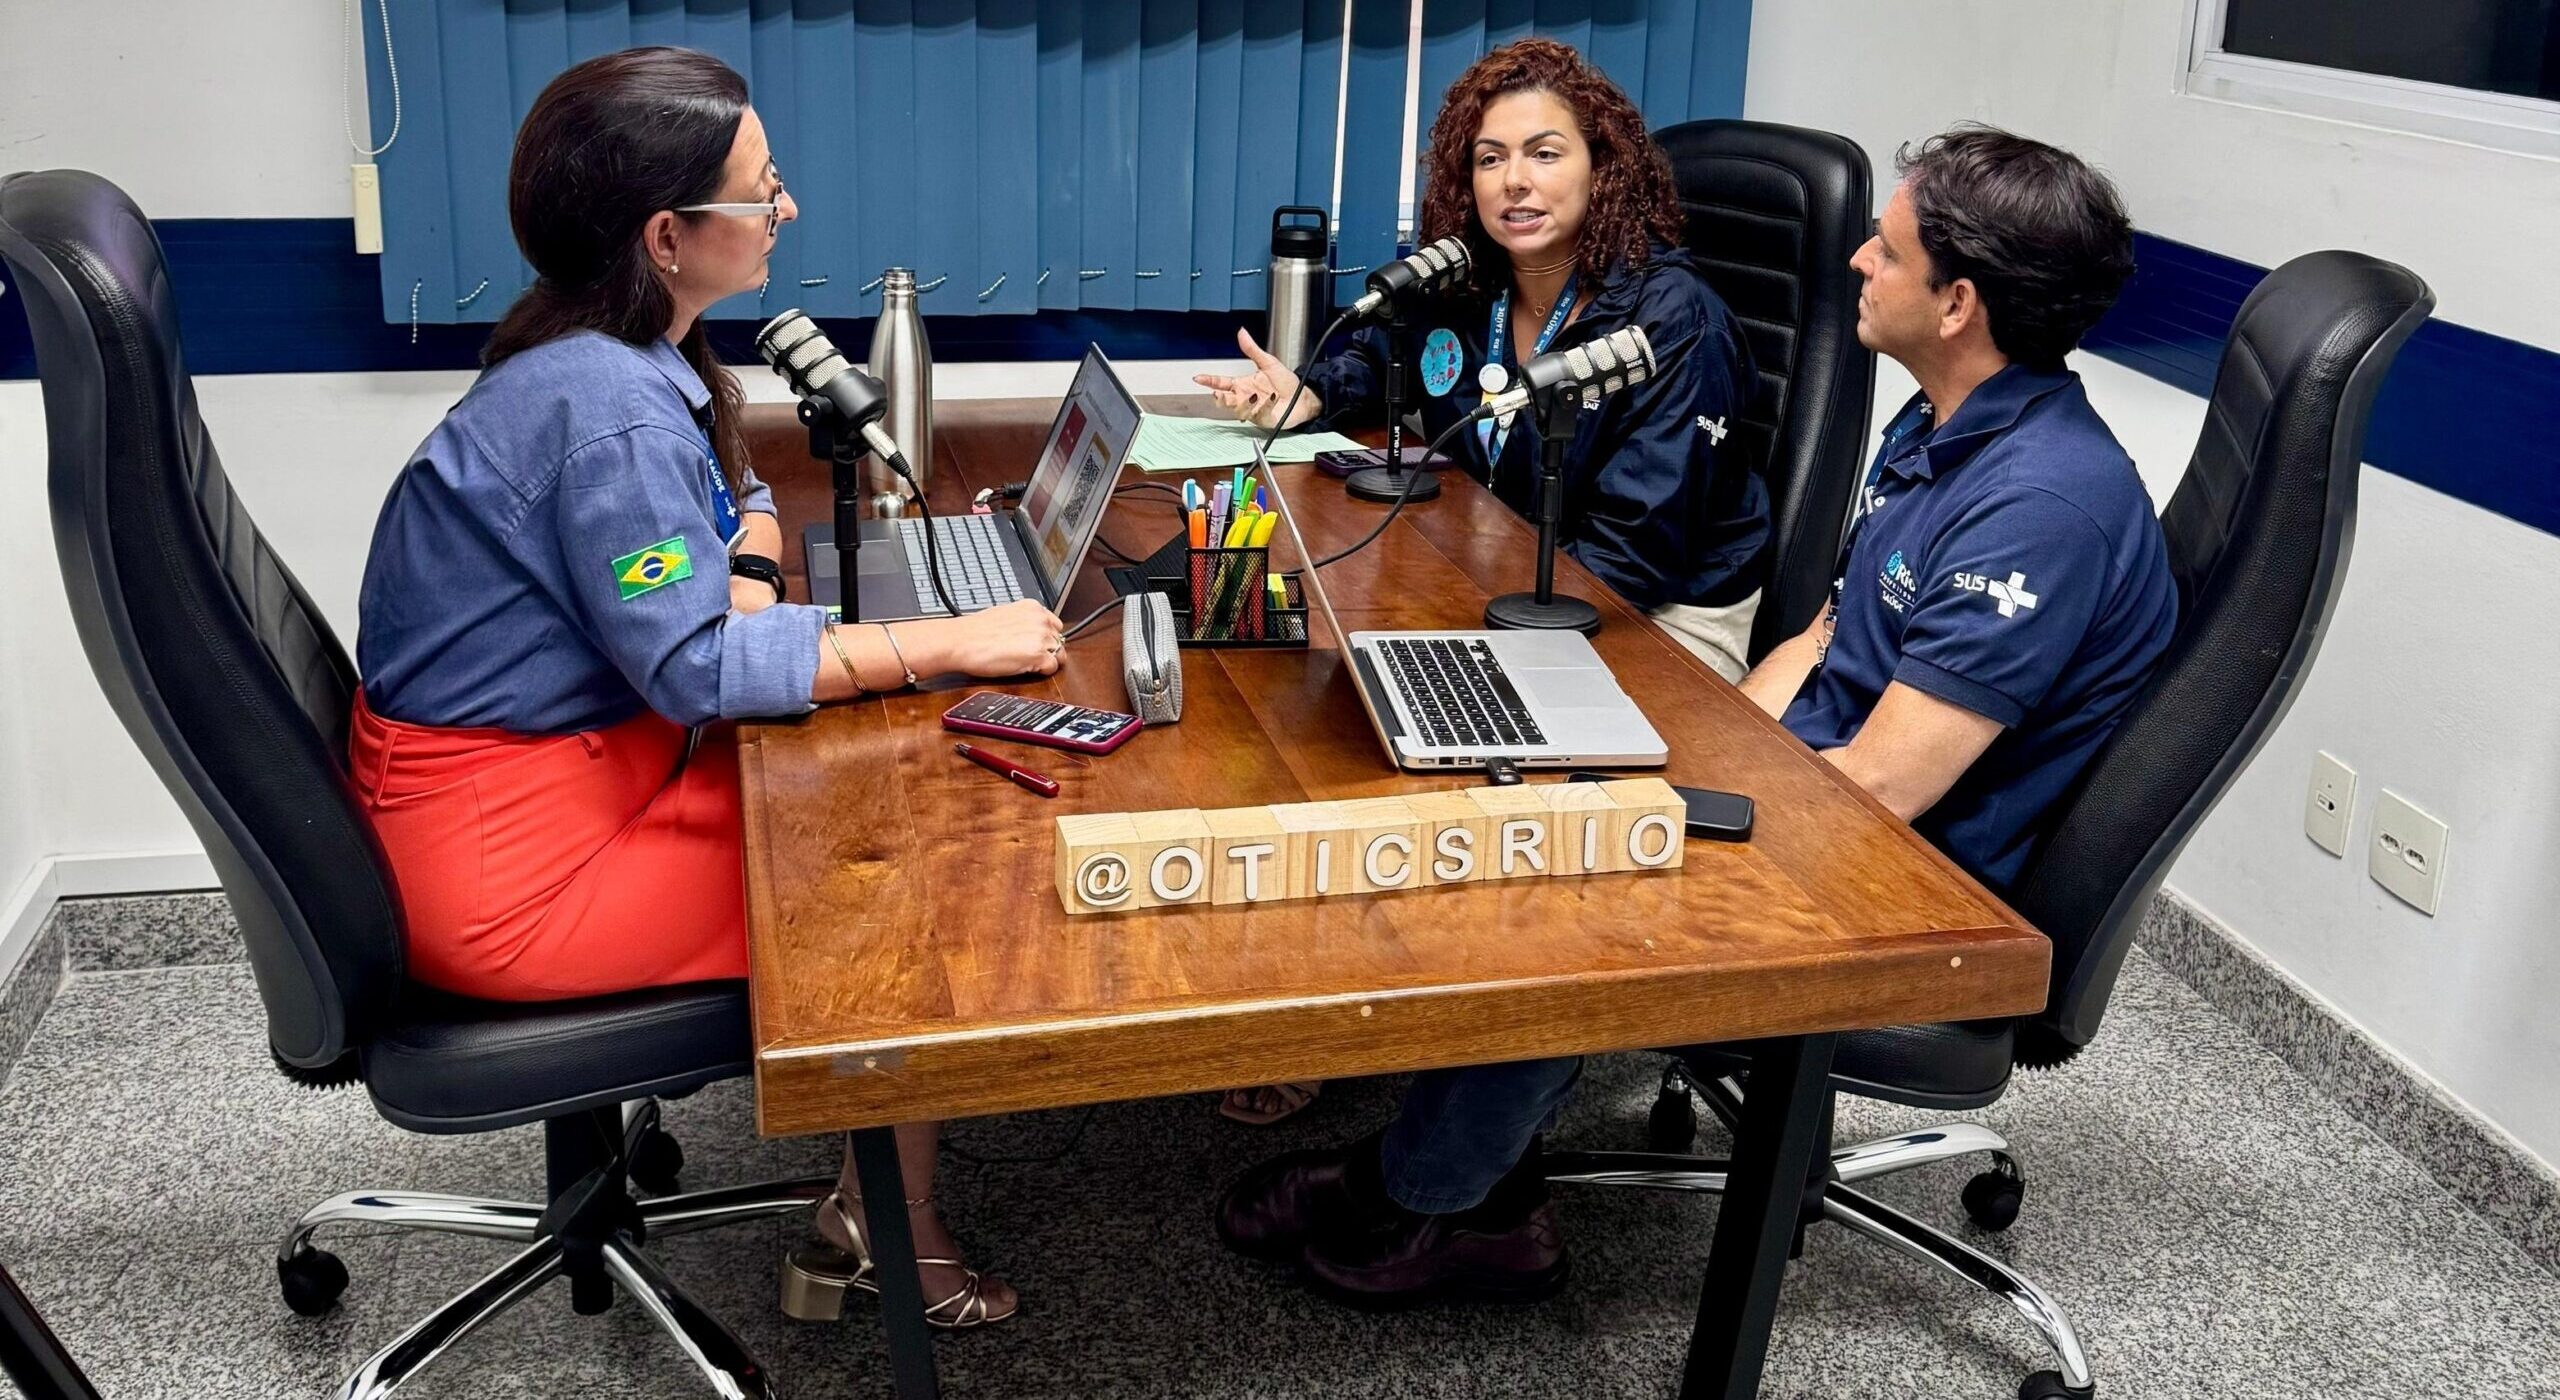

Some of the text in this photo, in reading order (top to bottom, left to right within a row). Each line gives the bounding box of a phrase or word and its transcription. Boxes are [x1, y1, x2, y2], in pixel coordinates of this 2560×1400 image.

[1494, 306, 1505, 334] SAÚDE
[1544, 310, 1562, 336] SAÚDE
[1697, 415, 1713, 430] SUS
[708, 458, 726, 493] SAÚDE
[1953, 572, 1987, 592] SUS
[1075, 814, 1678, 906] @OTICSRIO
